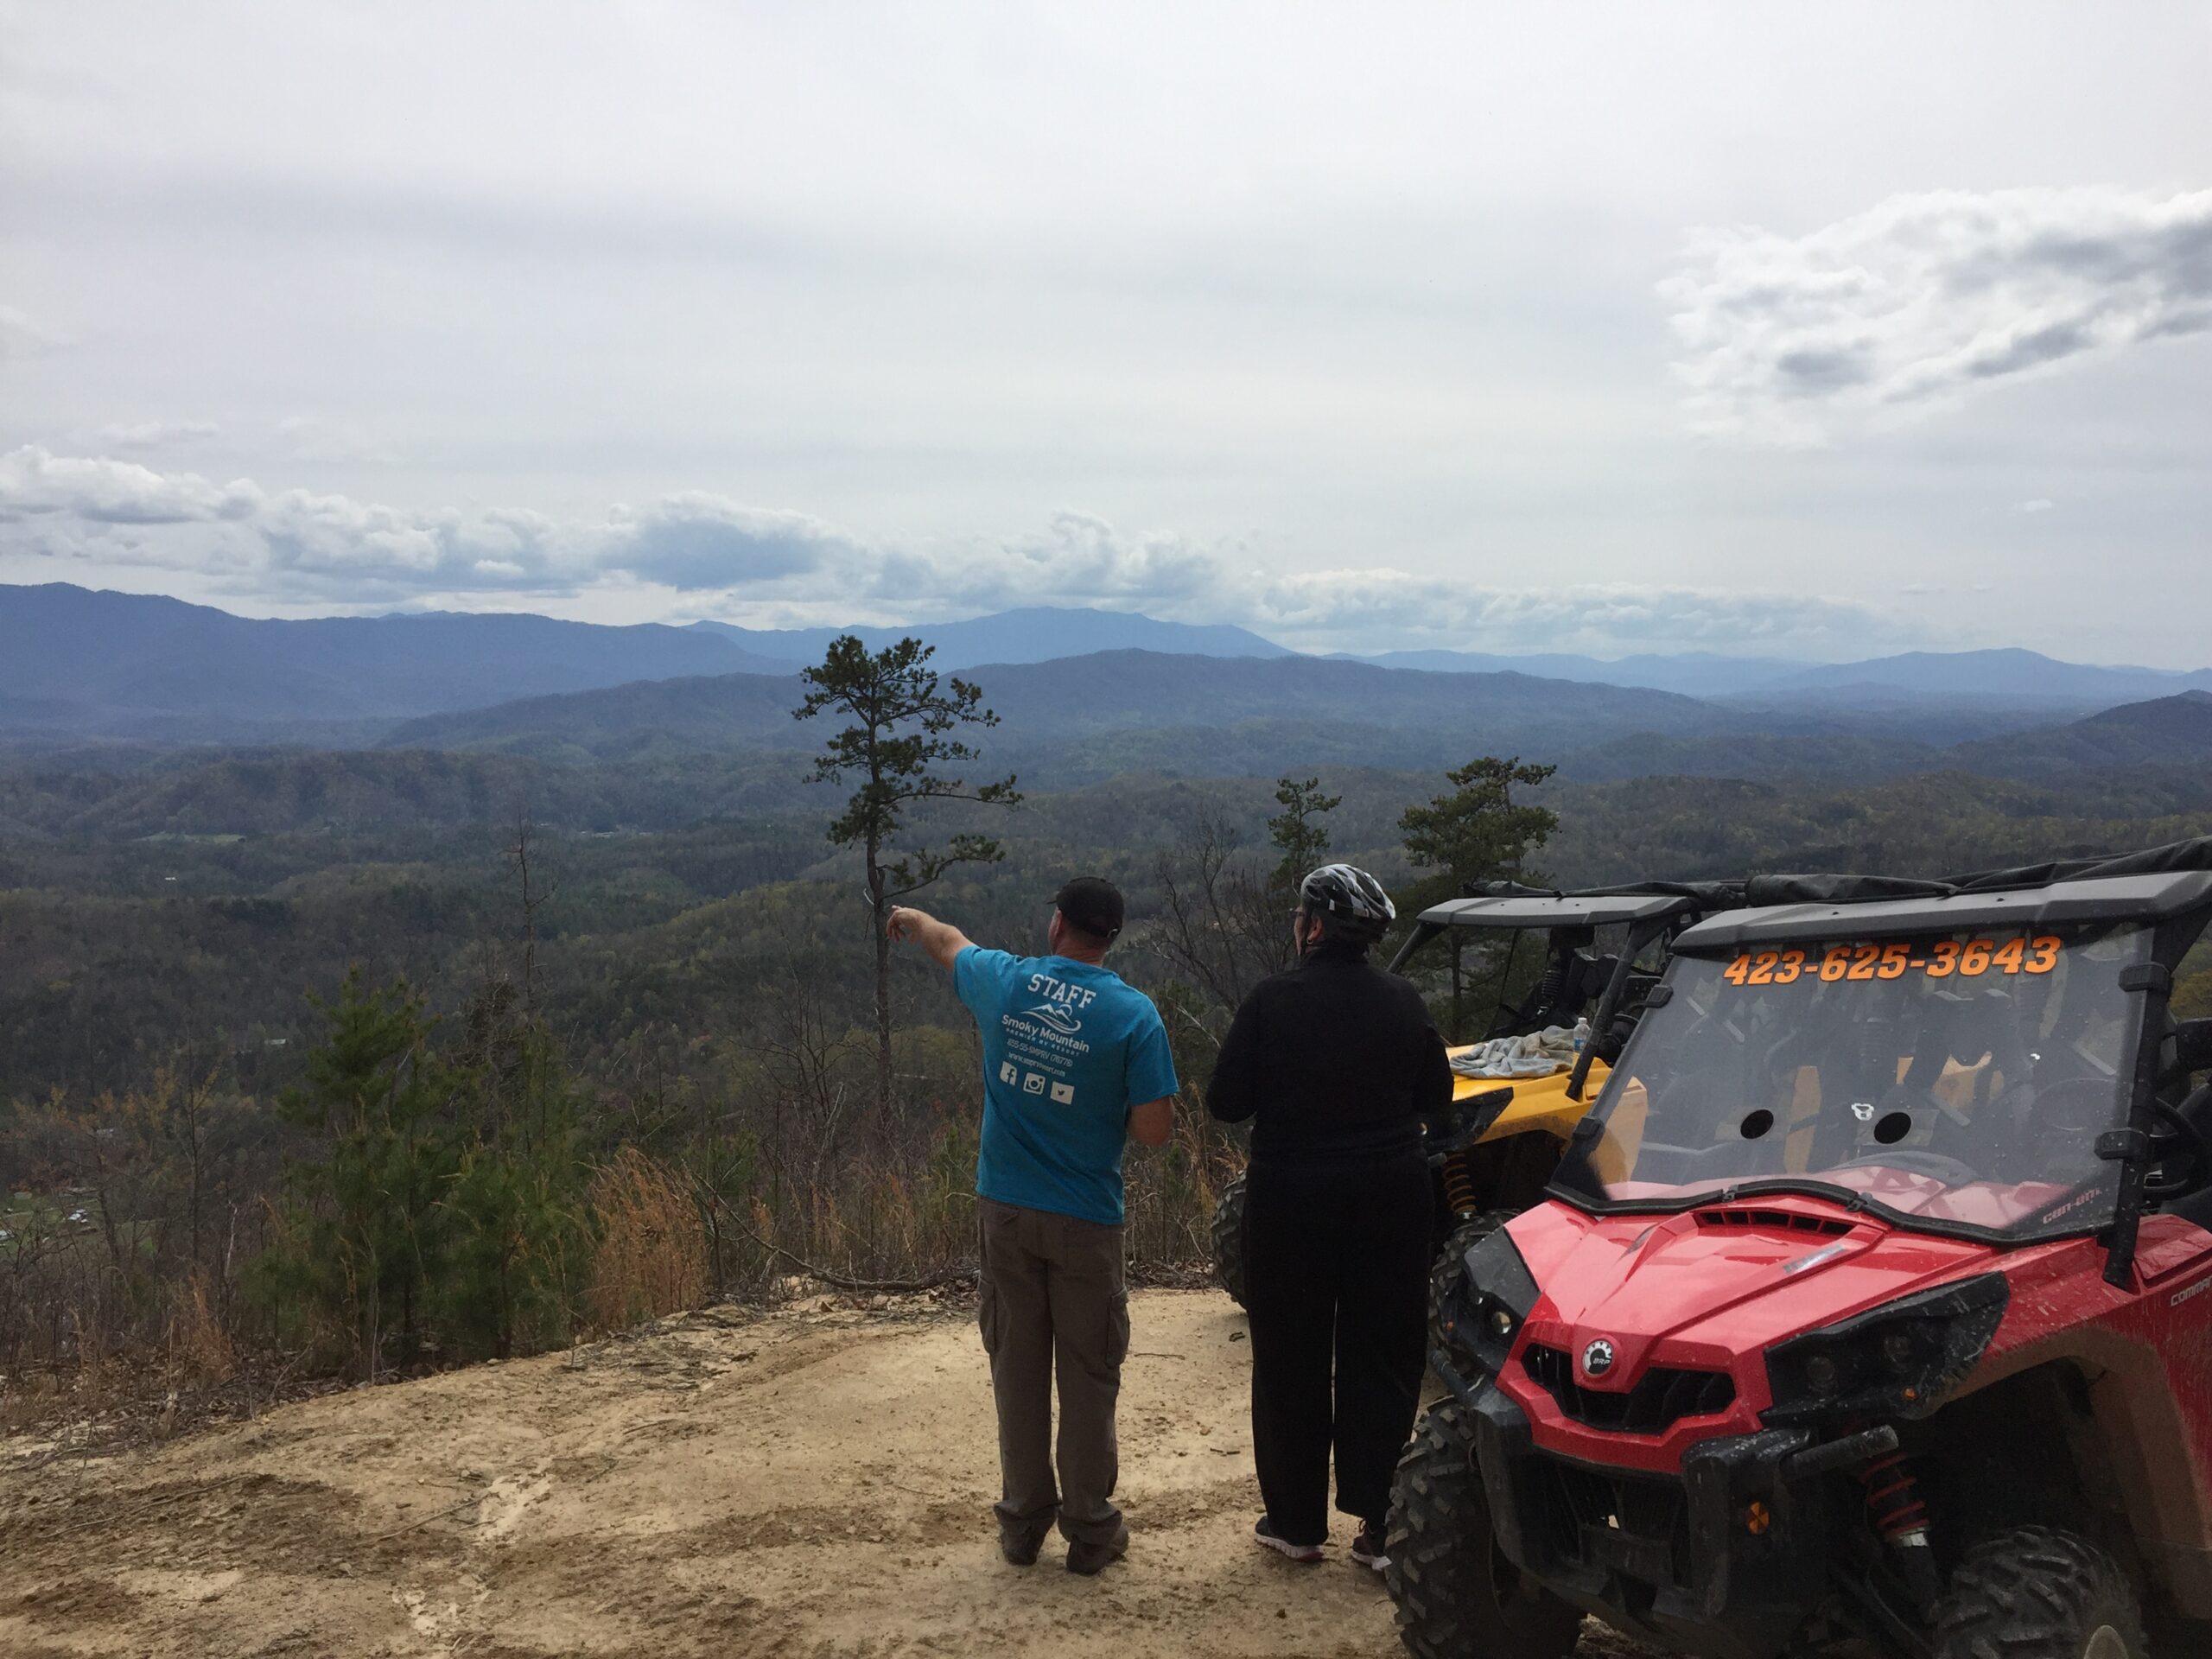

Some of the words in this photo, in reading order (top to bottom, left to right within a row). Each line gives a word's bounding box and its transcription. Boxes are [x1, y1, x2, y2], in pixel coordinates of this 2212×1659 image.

[1723, 937, 2062, 986] 423-625-3643
[1028, 974, 1096, 1008] STAFF
[1002, 1014, 1039, 1036] Smoky
[1039, 1027, 1090, 1052] Mountain
[1007, 1028, 1036, 1041] PREMIER
[1051, 1044, 1079, 1057] RESORT
